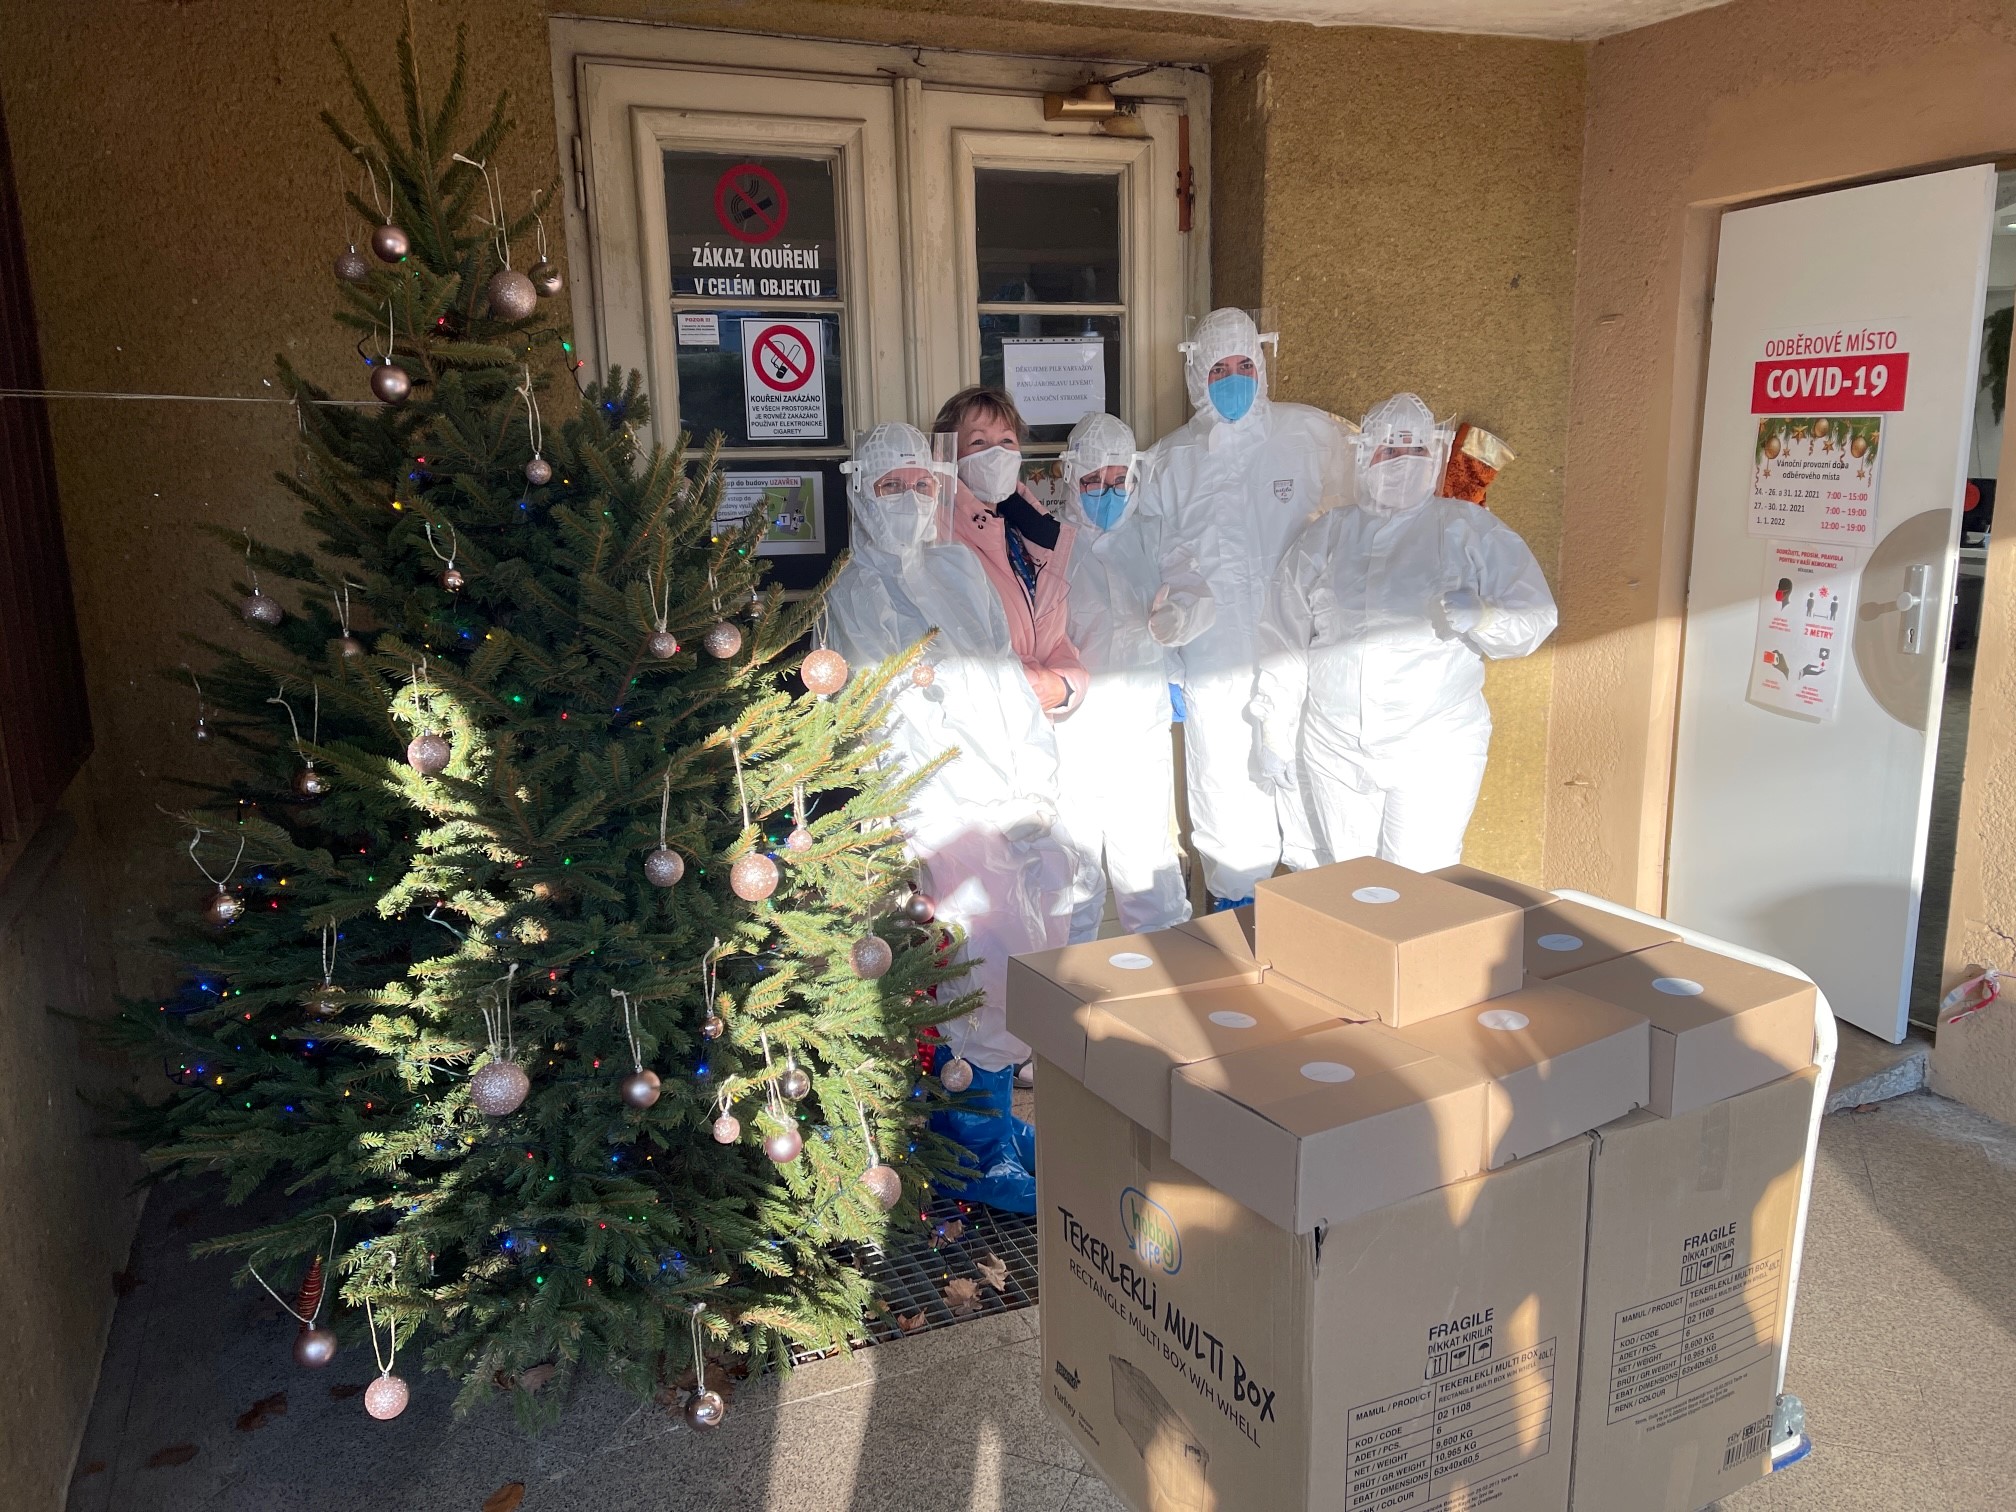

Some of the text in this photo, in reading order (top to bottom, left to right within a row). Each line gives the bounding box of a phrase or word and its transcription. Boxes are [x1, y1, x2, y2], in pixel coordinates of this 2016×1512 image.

[692, 242, 819, 269] ZÁKAZ KOUŘENÍ
[694, 274, 820, 296] V CELÉM OBJEKTU
[1766, 328, 1897, 357] ODBĚROVÉ MÍSTO
[1767, 364, 1888, 398] COVID-19
[750, 394, 820, 402] KOUŘENÍ ZAKÁZÁNO
[1777, 460, 1801, 468] Vánoční
[1803, 461, 1831, 469] provozní
[1782, 471, 1840, 480] odběrového místa
[1805, 490, 1820, 498] 2021
[1849, 493, 1868, 501] 15:00
[1821, 522, 1839, 530] 12:00
[1847, 524, 1866, 532] 19:00
[1848, 508, 1867, 516] 19:00
[1810, 629, 1833, 639] METRY
[1131, 1198, 1174, 1267] hobby
[1684, 1222, 1736, 1251] FRAGILE
[1682, 1238, 1735, 1264] DİKKAT KIRILIR
[1622, 1311, 1646, 1324] MAMUL
[1652, 1296, 1684, 1314] PRODUCT
[1734, 1267, 1754, 1281] MULTI
[1755, 1261, 1769, 1273] BOX
[1429, 1308, 1494, 1340] FRAGILE
[1462, 1325, 1492, 1344] KIRILIR
[1620, 1307, 1714, 1348] KOD CODE 02 1108
[1070, 1258, 1261, 1448] RECTANGLE MULTI BOX W/H WHELL
[1618, 1364, 1632, 1374] NET
[1637, 1353, 1662, 1368] WEIGHT
[1704, 1332, 1714, 1342] KG
[1619, 1329, 1690, 1361] ADET PCS. 6
[1164, 1302, 1223, 1381] MULTI
[1233, 1355, 1275, 1423] BOX
[1617, 1375, 1636, 1388] BRÜT
[1706, 1343, 1717, 1353] KG
[1356, 1406, 1386, 1421] MAMUL
[1440, 1368, 1493, 1392] TEKERLEKLİ
[1495, 1357, 1519, 1373] MULTI
[1521, 1349, 1538, 1362] BOX
[1438, 1385, 1474, 1403] RECTANGLE
[1476, 1380, 1492, 1390] MULTI
[1494, 1375, 1505, 1383] BOX
[1615, 1386, 1666, 1413] RENK COLOUR
[1616, 1388, 1633, 1400] EBAT
[1638, 1371, 1678, 1392] DIMENSIONS
[1054, 1384, 1076, 1417] Turkey
[1356, 1402, 1471, 1448] KOD CODE 02 1108
[1354, 1466, 1370, 1478] NET
[1377, 1453, 1408, 1469] WEIGHT
[1460, 1430, 1473, 1440] KG
[1355, 1426, 1442, 1463] ADET PCS. 6
[1354, 1479, 1375, 1492] BRÜT
[1464, 1441, 1477, 1452] KG
[1353, 1492, 1374, 1505] EBAT
[1380, 1472, 1429, 1496] DIMENSIONS
[1381, 1492, 1414, 1509] COLOUR
